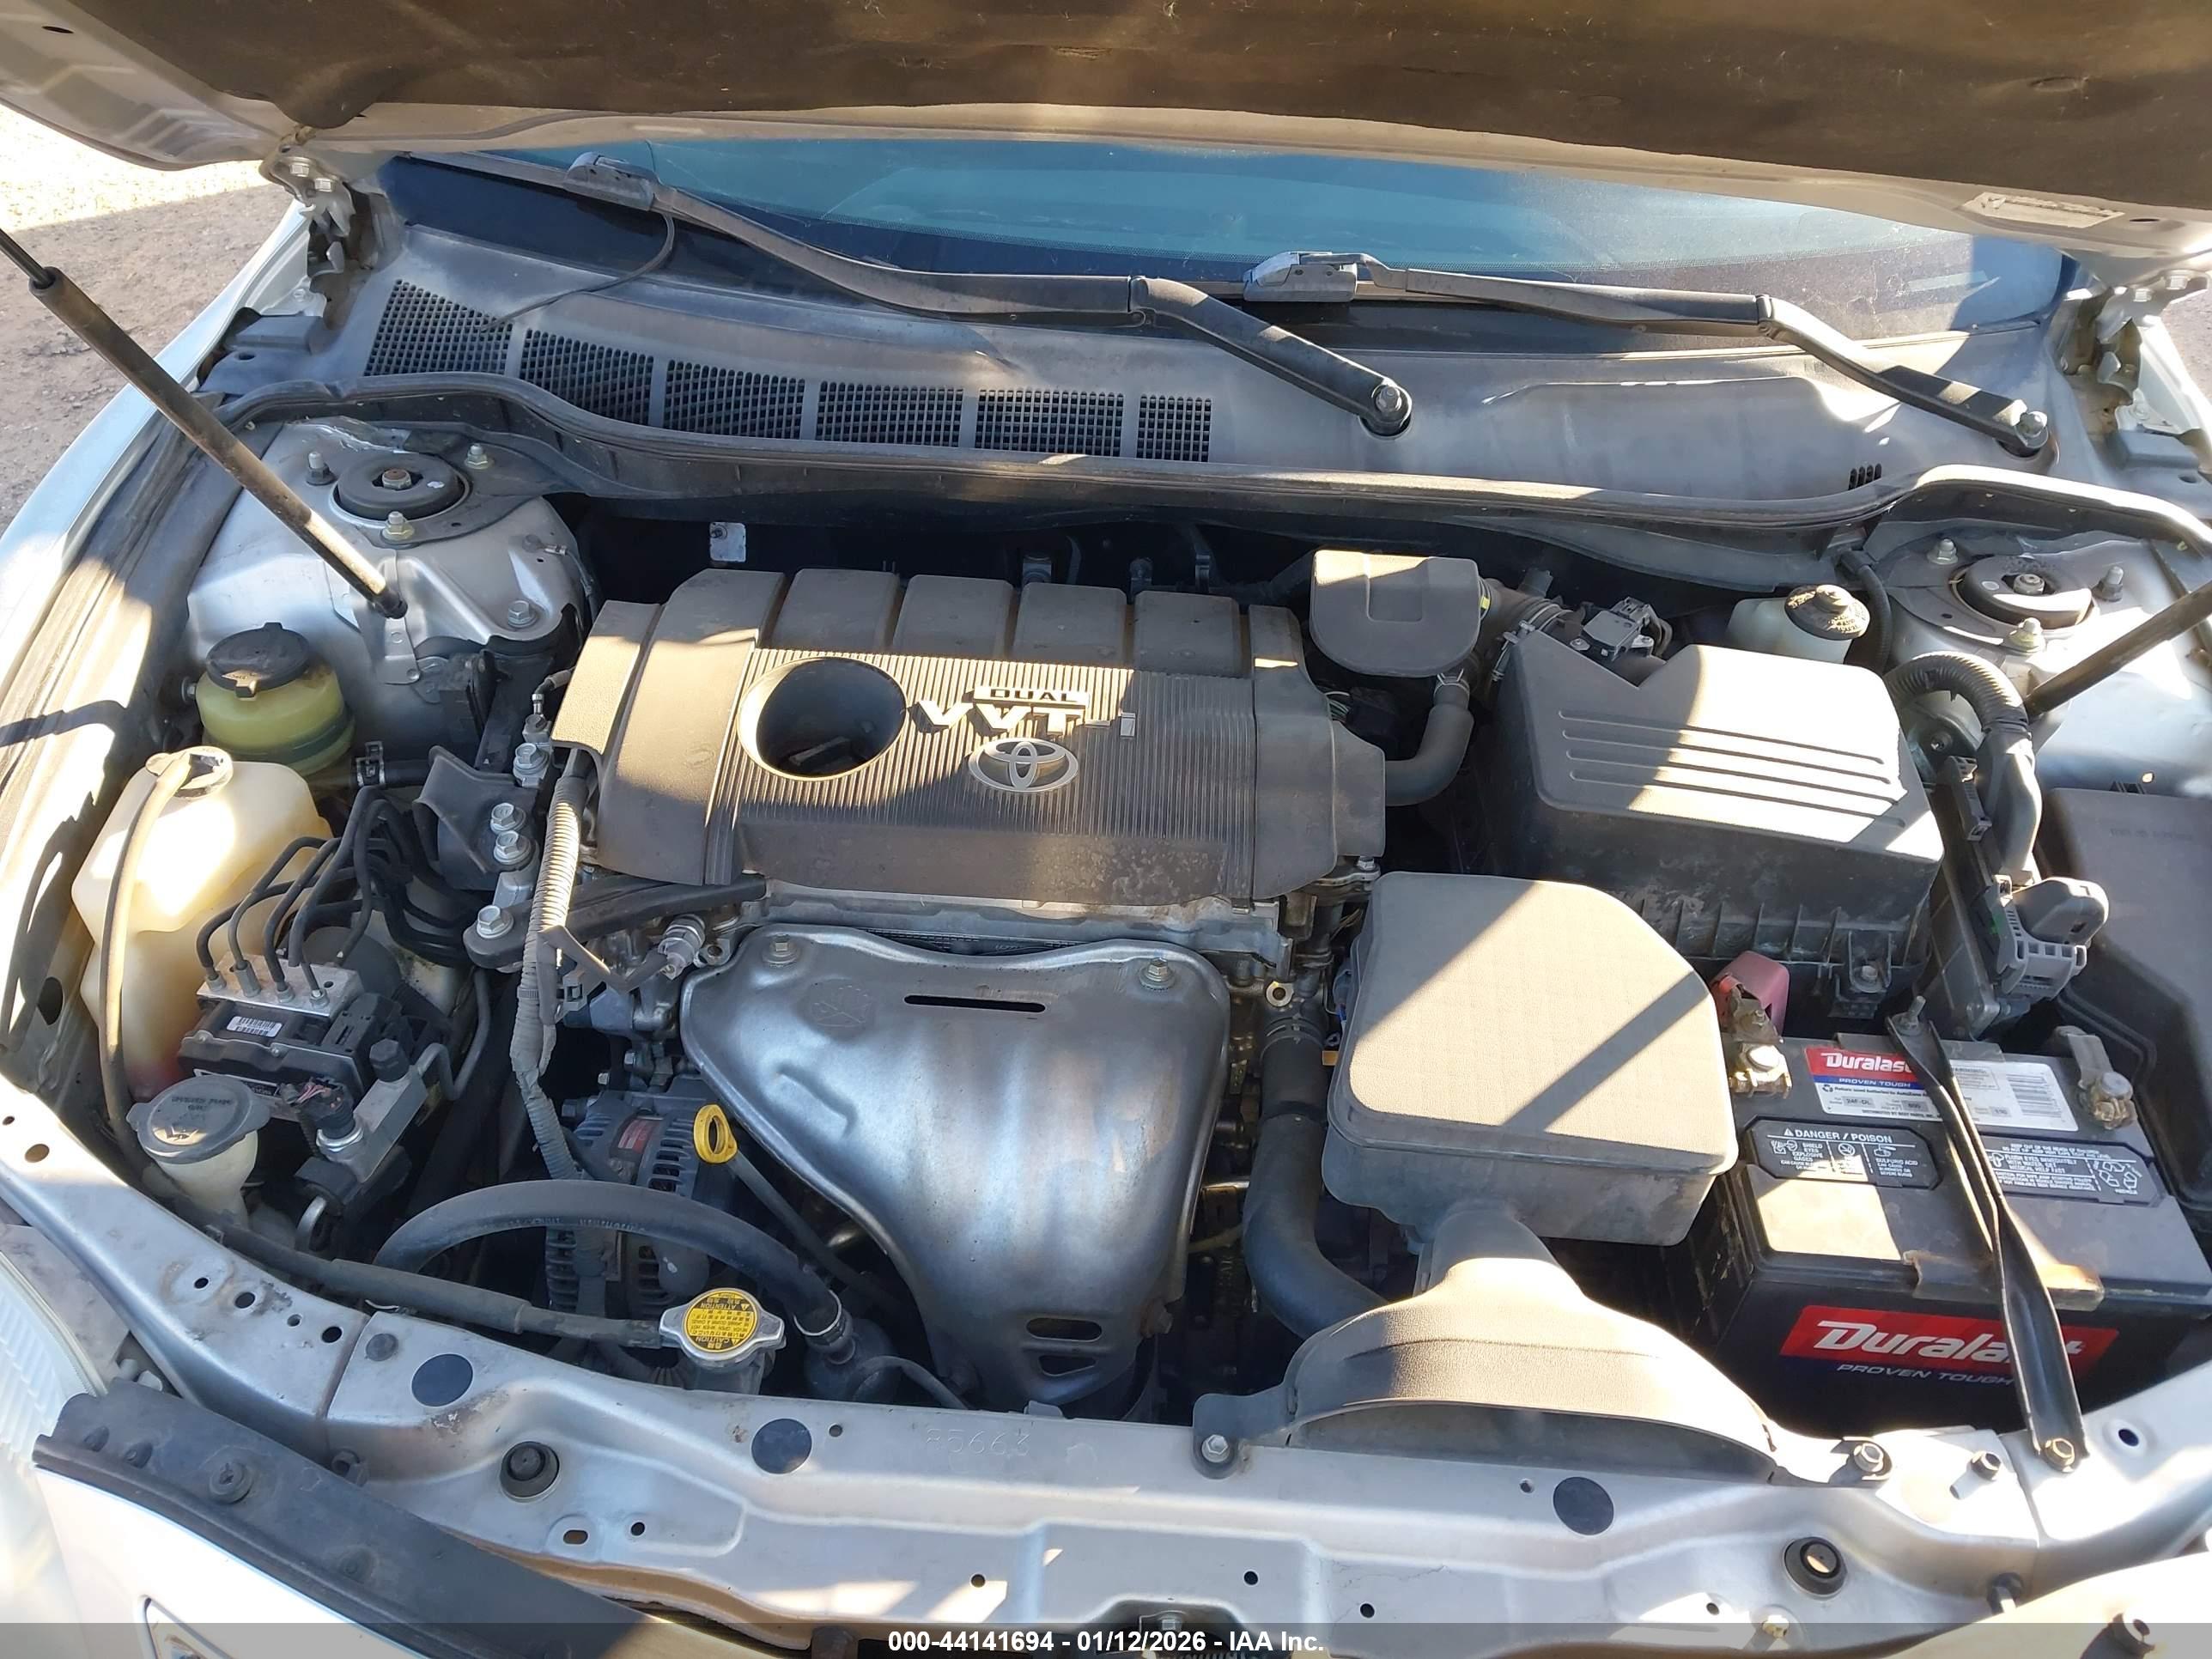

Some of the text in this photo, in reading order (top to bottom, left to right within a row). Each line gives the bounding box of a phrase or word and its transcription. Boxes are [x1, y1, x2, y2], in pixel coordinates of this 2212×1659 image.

[990, 688, 1079, 702] DUAL
[917, 700, 1136, 738] VVT-i
[1795, 1128, 1893, 1144] DANGER / POISON
[1836, 1364, 2014, 1387] PROVEN TOUGH
